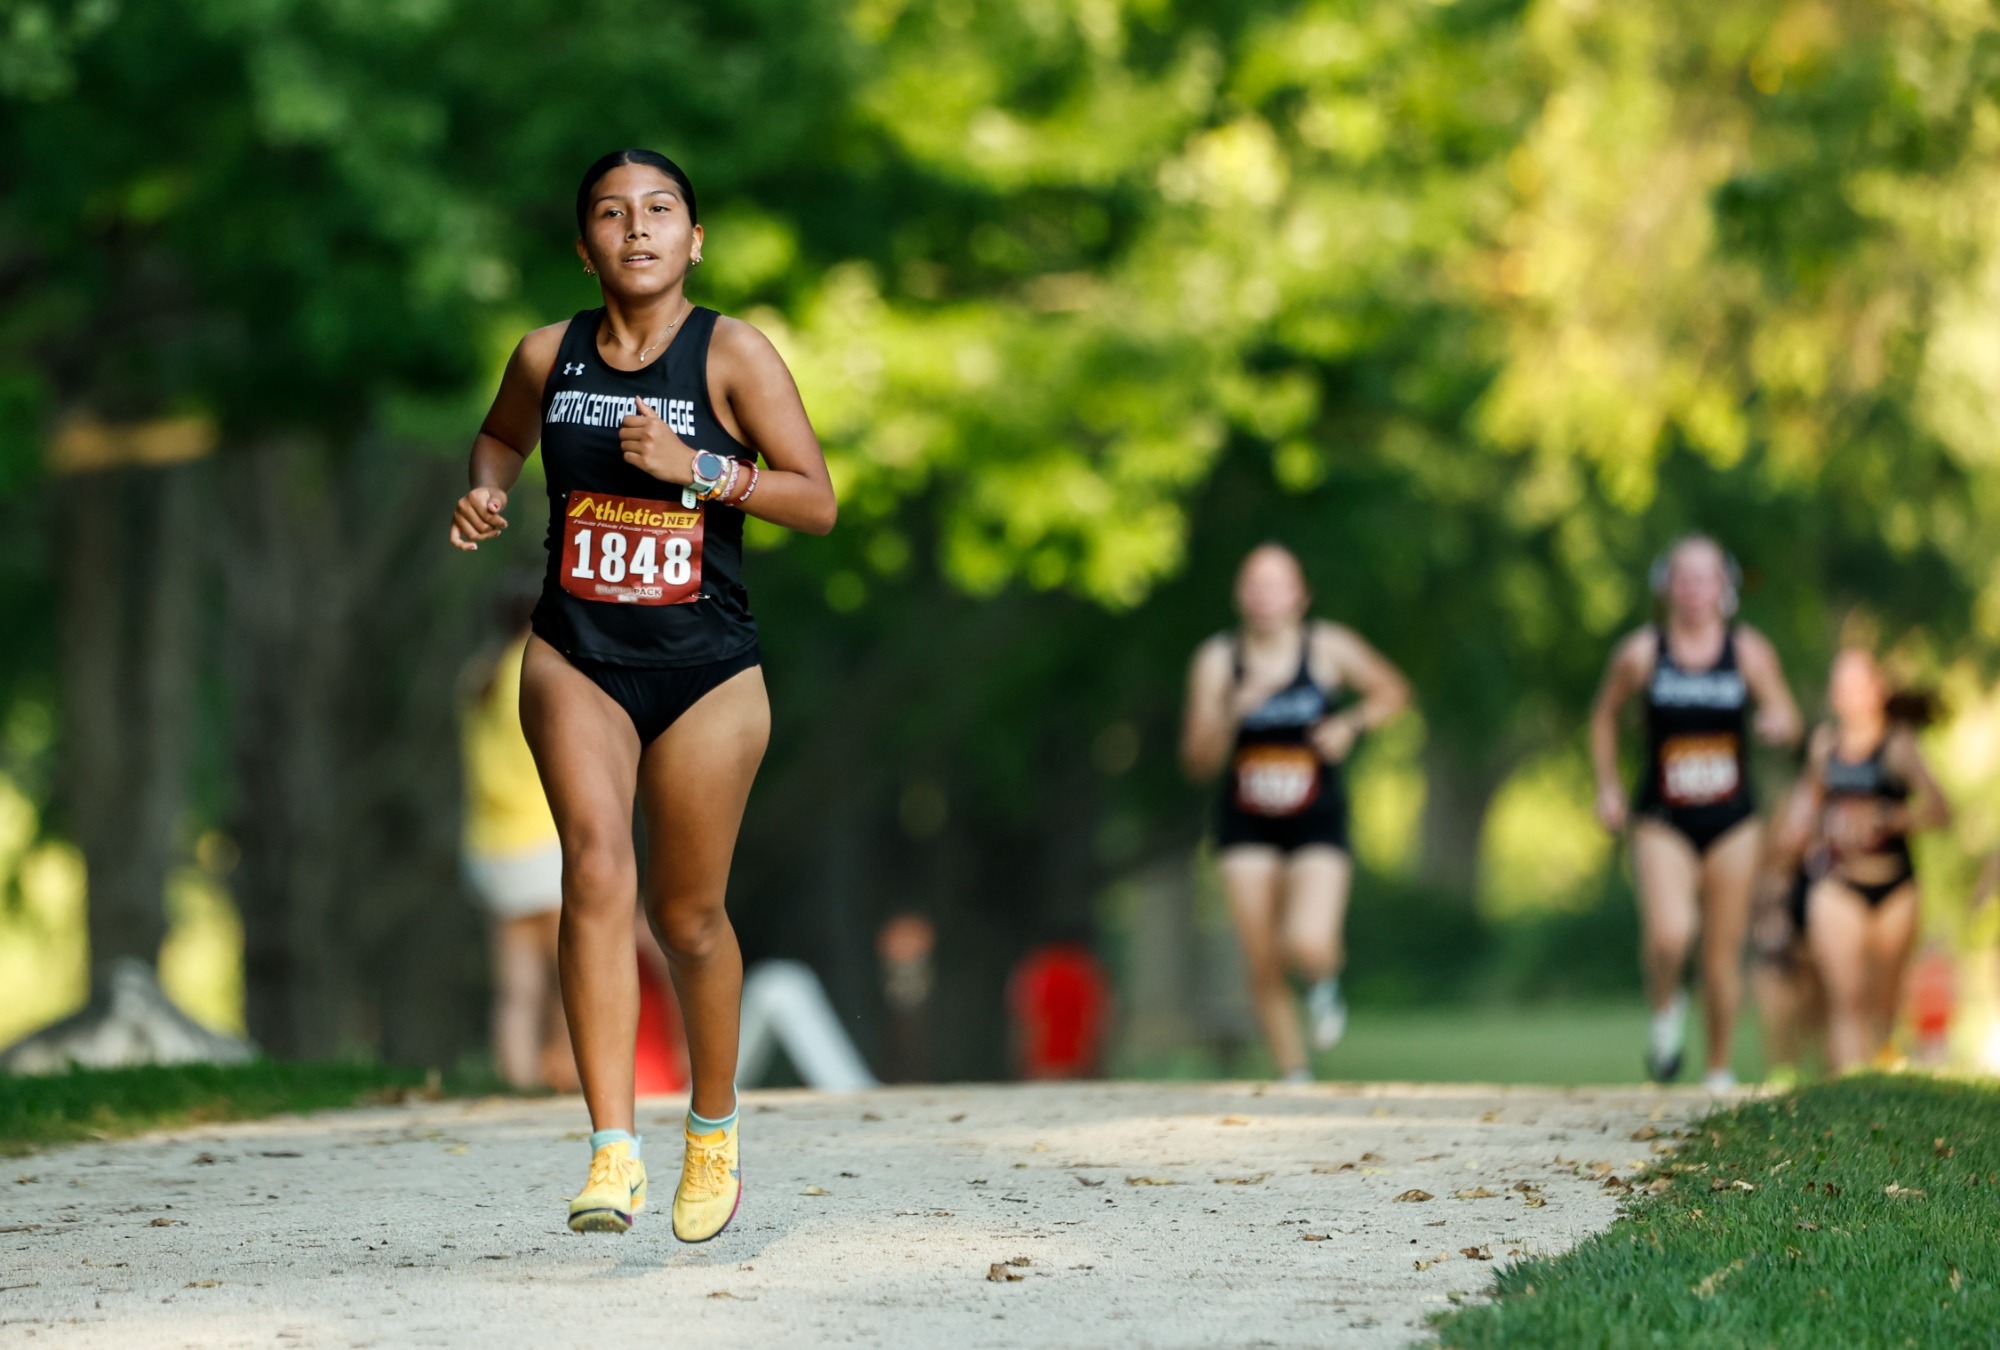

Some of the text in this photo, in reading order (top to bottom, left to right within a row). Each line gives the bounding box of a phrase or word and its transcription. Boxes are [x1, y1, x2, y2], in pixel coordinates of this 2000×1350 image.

[545, 390, 588, 424] NORTH
[571, 529, 692, 586] 1848
[634, 587, 661, 597] PACK
